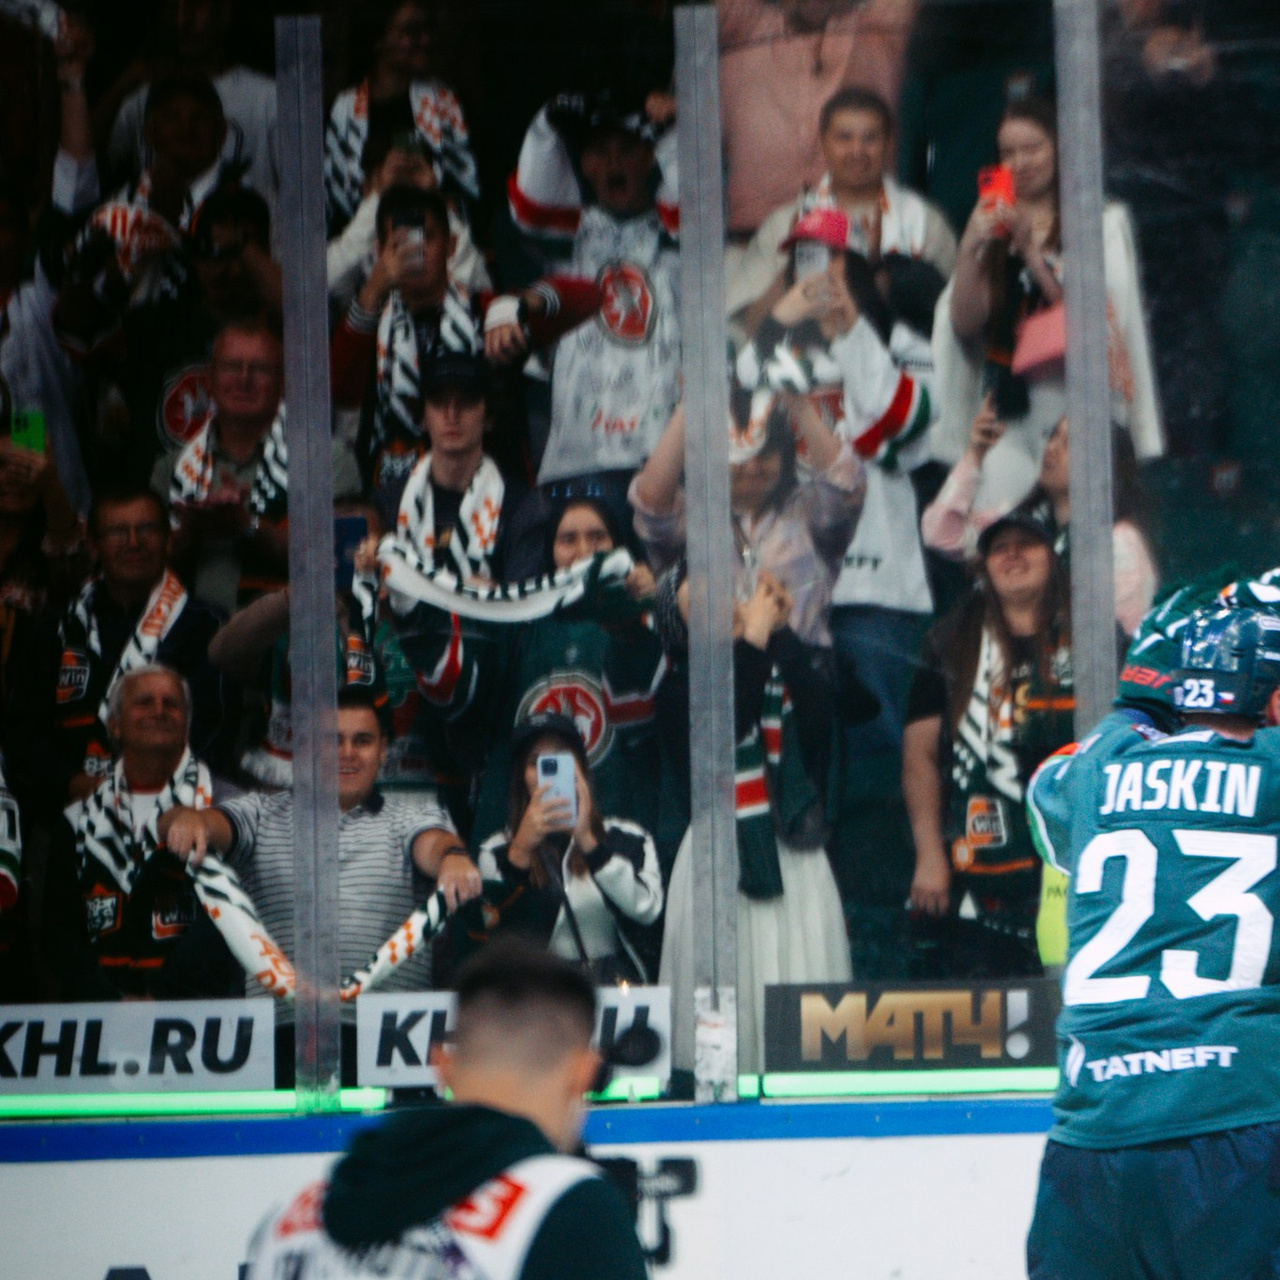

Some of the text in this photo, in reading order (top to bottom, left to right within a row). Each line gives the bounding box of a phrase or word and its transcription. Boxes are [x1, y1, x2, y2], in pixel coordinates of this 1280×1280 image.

[1184, 678, 1215, 708] 23
[1100, 760, 1262, 818] JASKIN
[1063, 828, 1278, 1006] 23
[1086, 1044, 1239, 1083] TATNEFT
